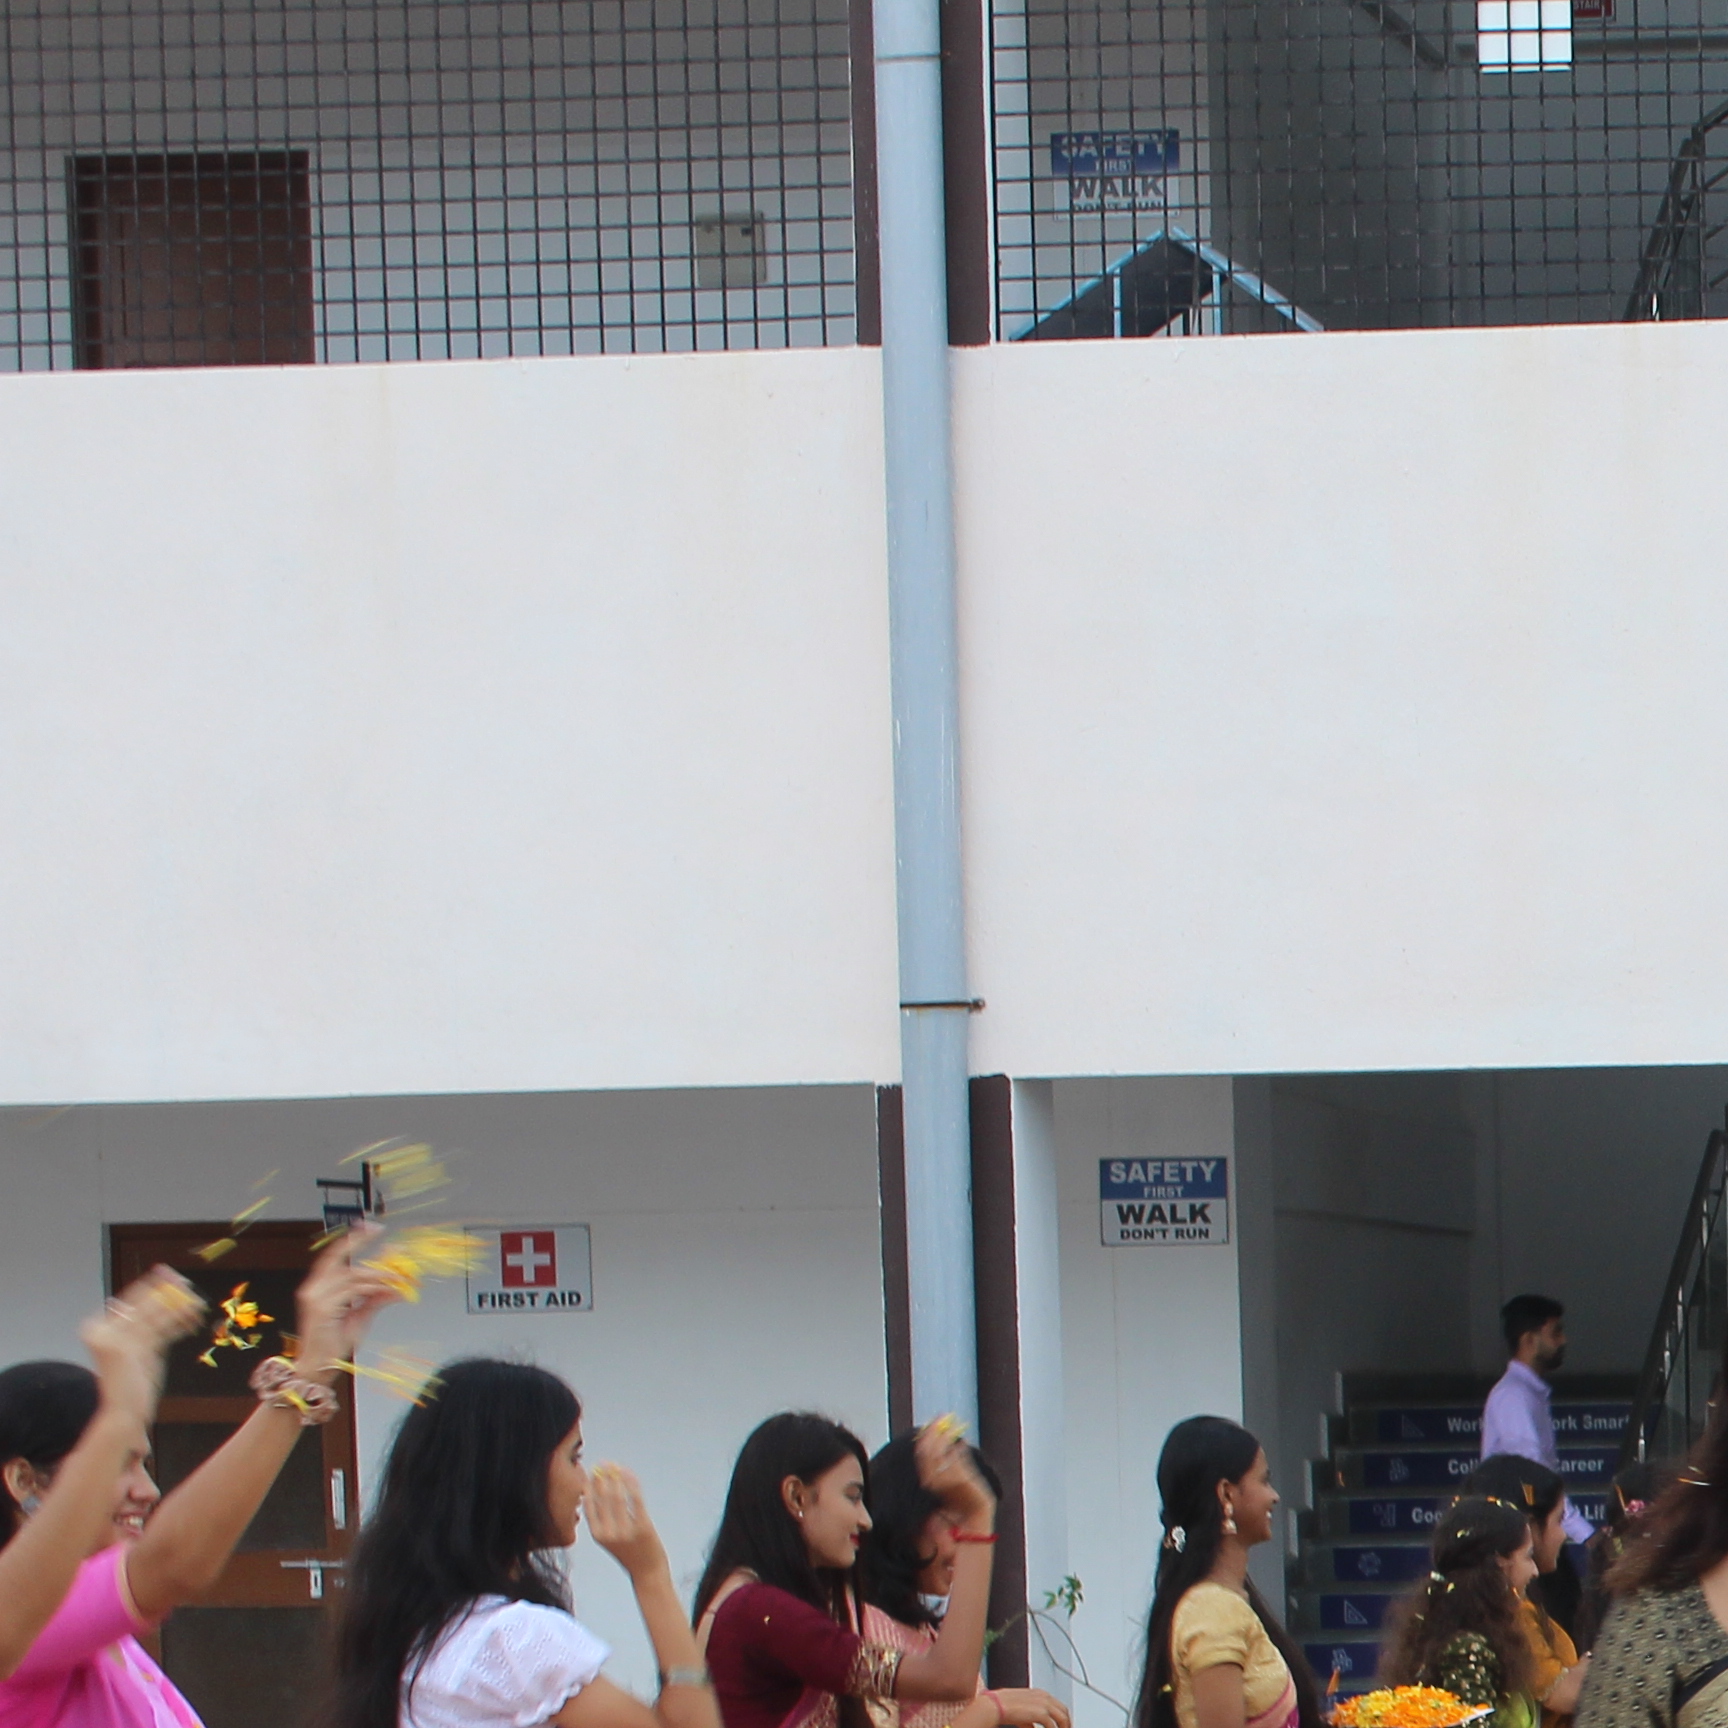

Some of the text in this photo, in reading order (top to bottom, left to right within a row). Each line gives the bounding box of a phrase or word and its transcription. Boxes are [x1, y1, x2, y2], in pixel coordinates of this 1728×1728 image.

[1069, 176, 1165, 199] WALK
[1109, 1161, 1217, 1184] SAFETY
[1143, 1186, 1184, 1198] FIRST
[1116, 1203, 1212, 1226] WALK
[1120, 1228, 1210, 1240] DON'T RUN
[477, 1291, 582, 1309] FIRST AID
[1551, 1414, 1578, 1430] ork
